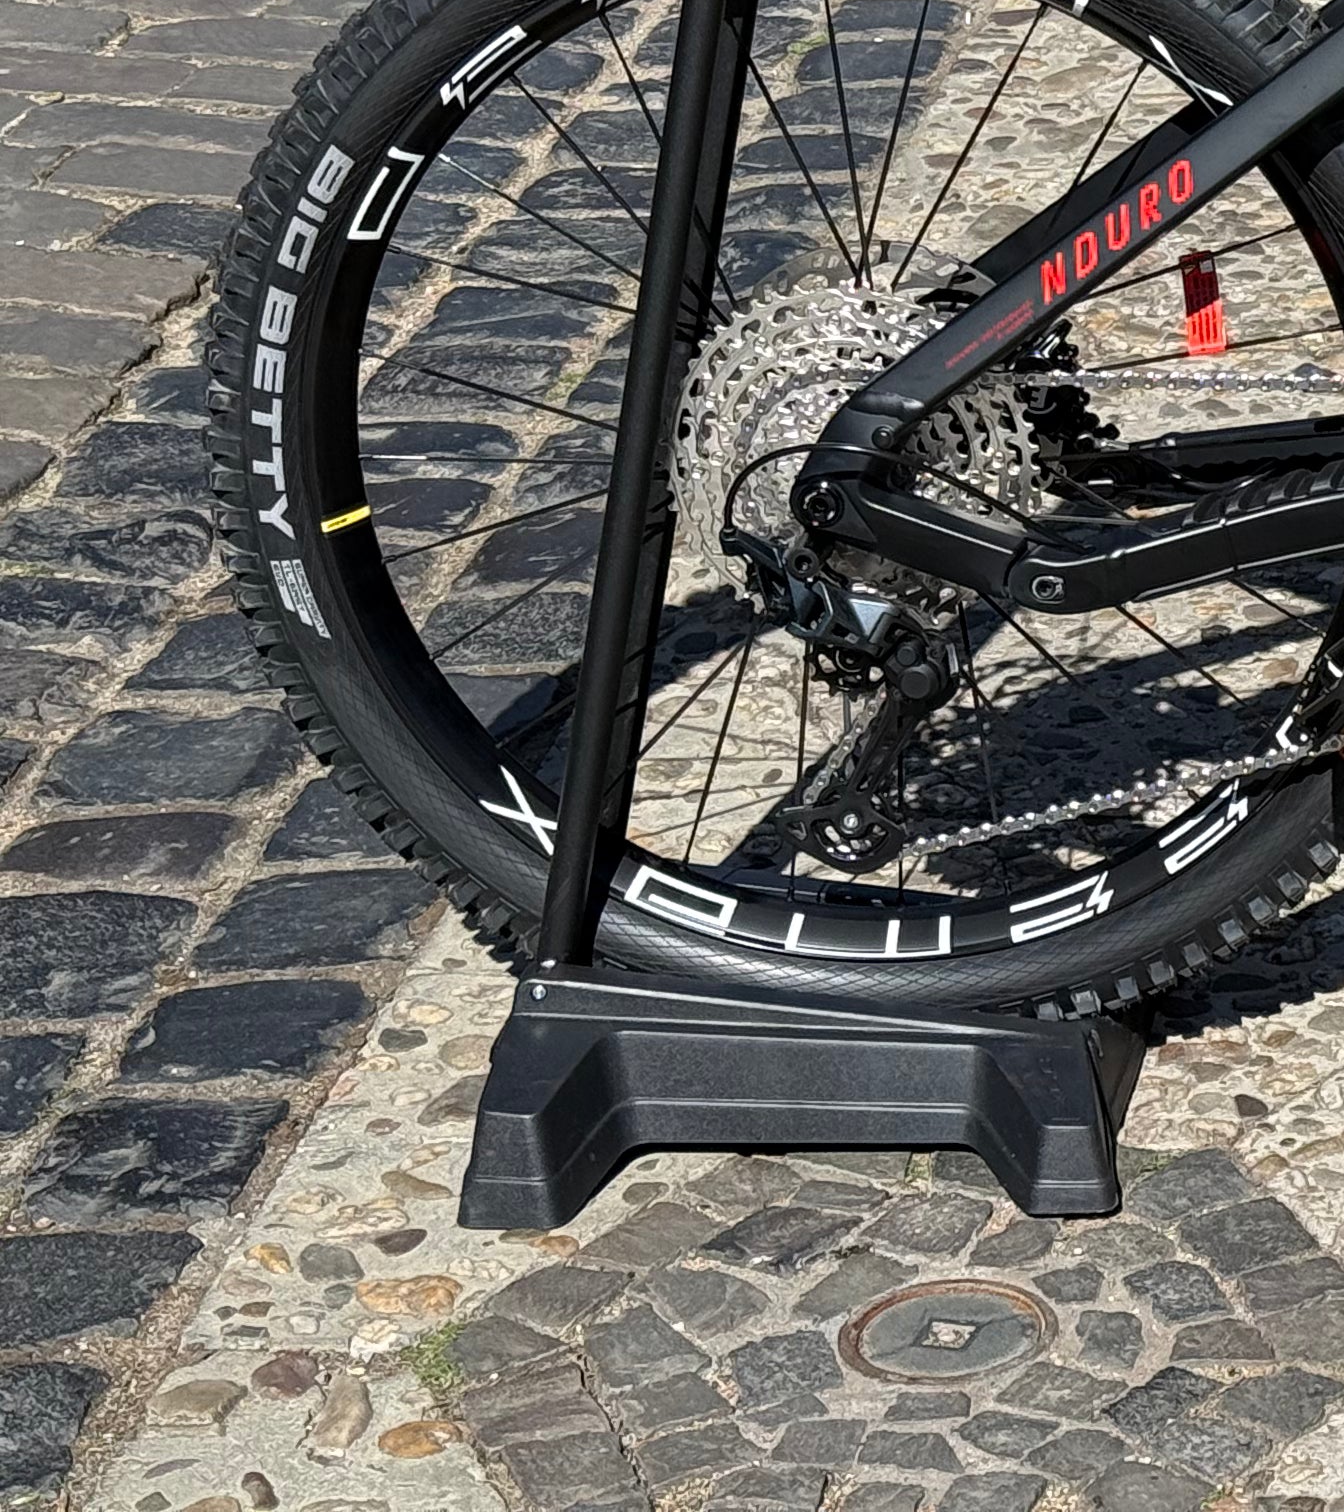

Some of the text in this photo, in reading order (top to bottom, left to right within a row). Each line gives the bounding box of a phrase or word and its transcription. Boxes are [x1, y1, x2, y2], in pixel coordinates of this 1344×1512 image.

[250, 143, 354, 539] BIG BETTY
[1040, 159, 1195, 306] NDURO
